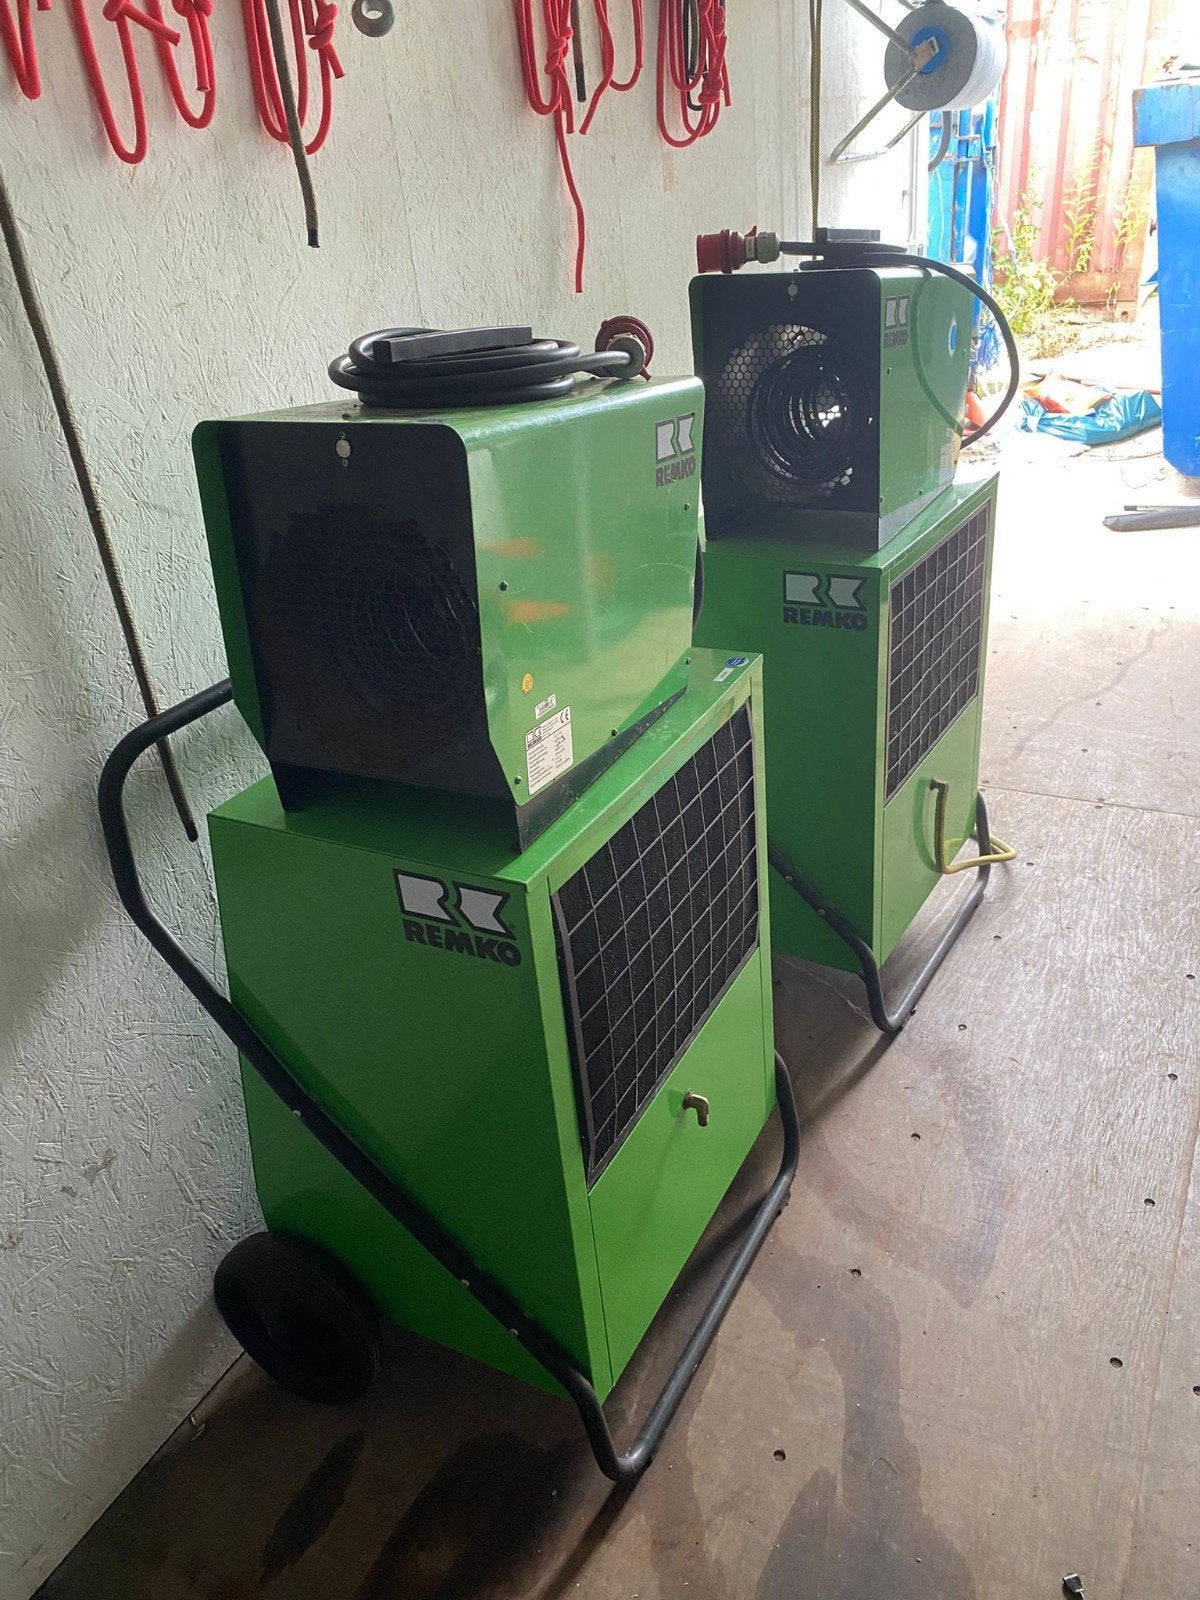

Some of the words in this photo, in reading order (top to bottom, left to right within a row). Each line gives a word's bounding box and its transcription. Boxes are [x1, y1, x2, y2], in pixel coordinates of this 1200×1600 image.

[655, 455, 696, 488] REMKO
[783, 606, 868, 631] REMKO
[402, 919, 522, 967] REMKO
